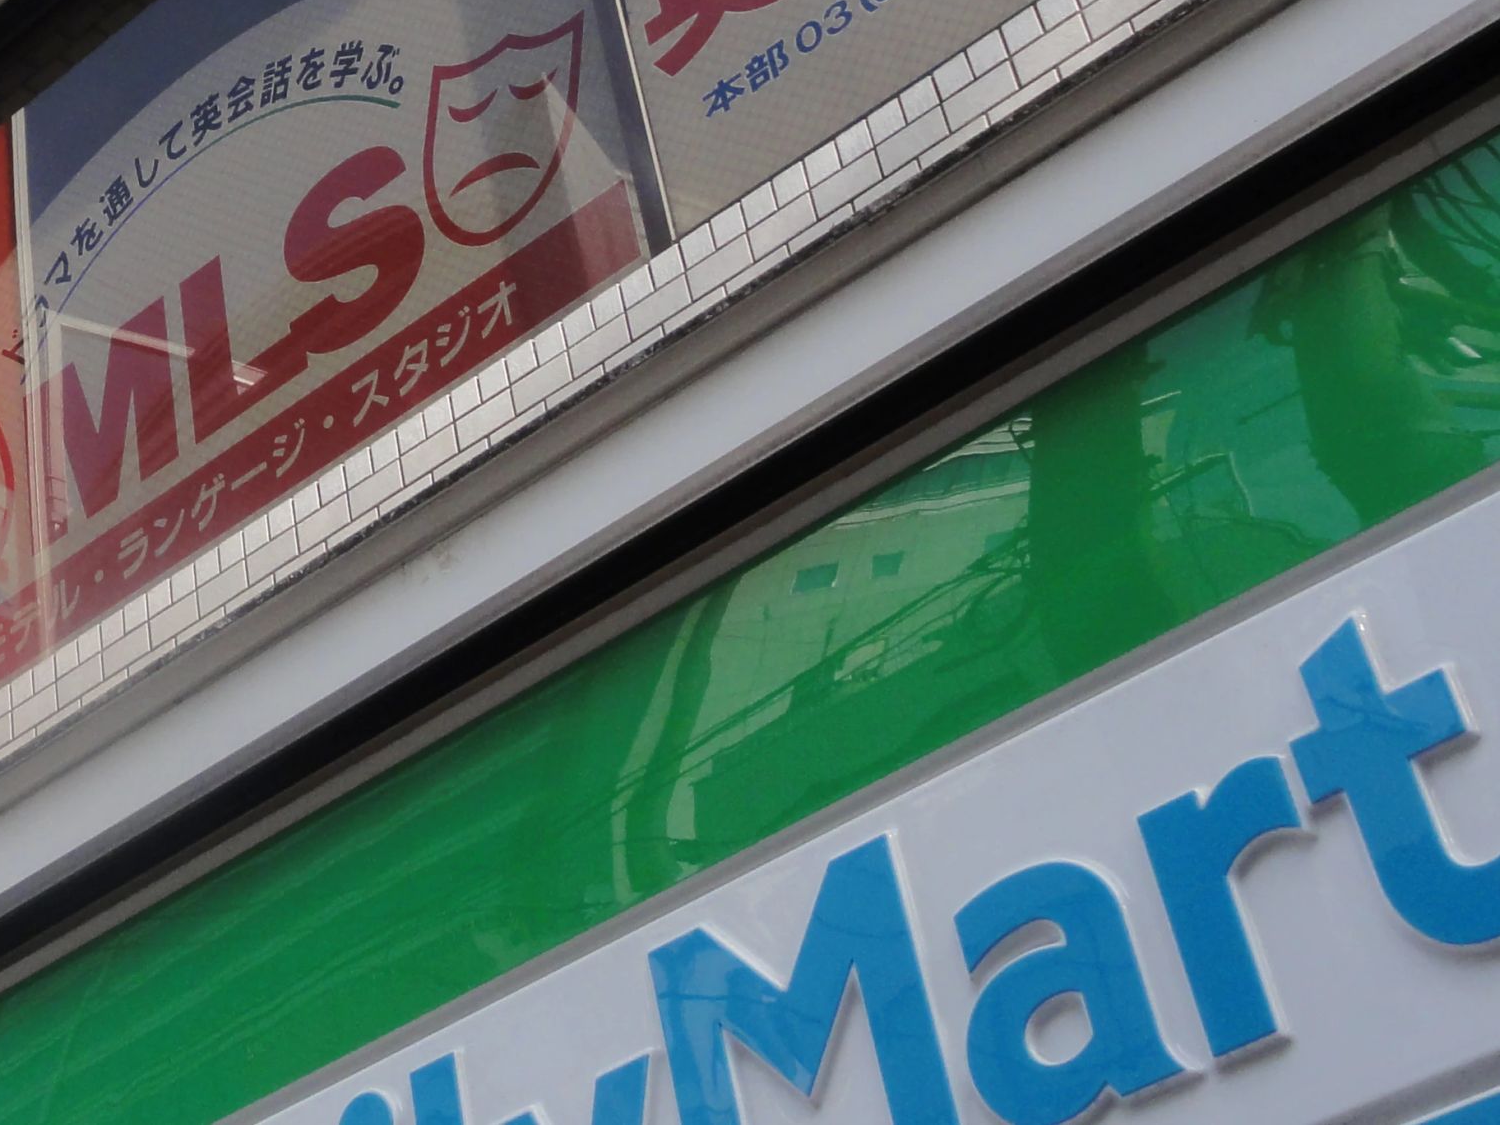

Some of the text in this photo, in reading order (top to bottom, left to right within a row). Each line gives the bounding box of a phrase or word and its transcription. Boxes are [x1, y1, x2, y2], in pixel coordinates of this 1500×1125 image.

[702, 39, 789, 117] 本部
[795, 0, 854, 54] 03
[23, 145, 426, 557] MLS
[338, 613, 1500, 1125] Mart
